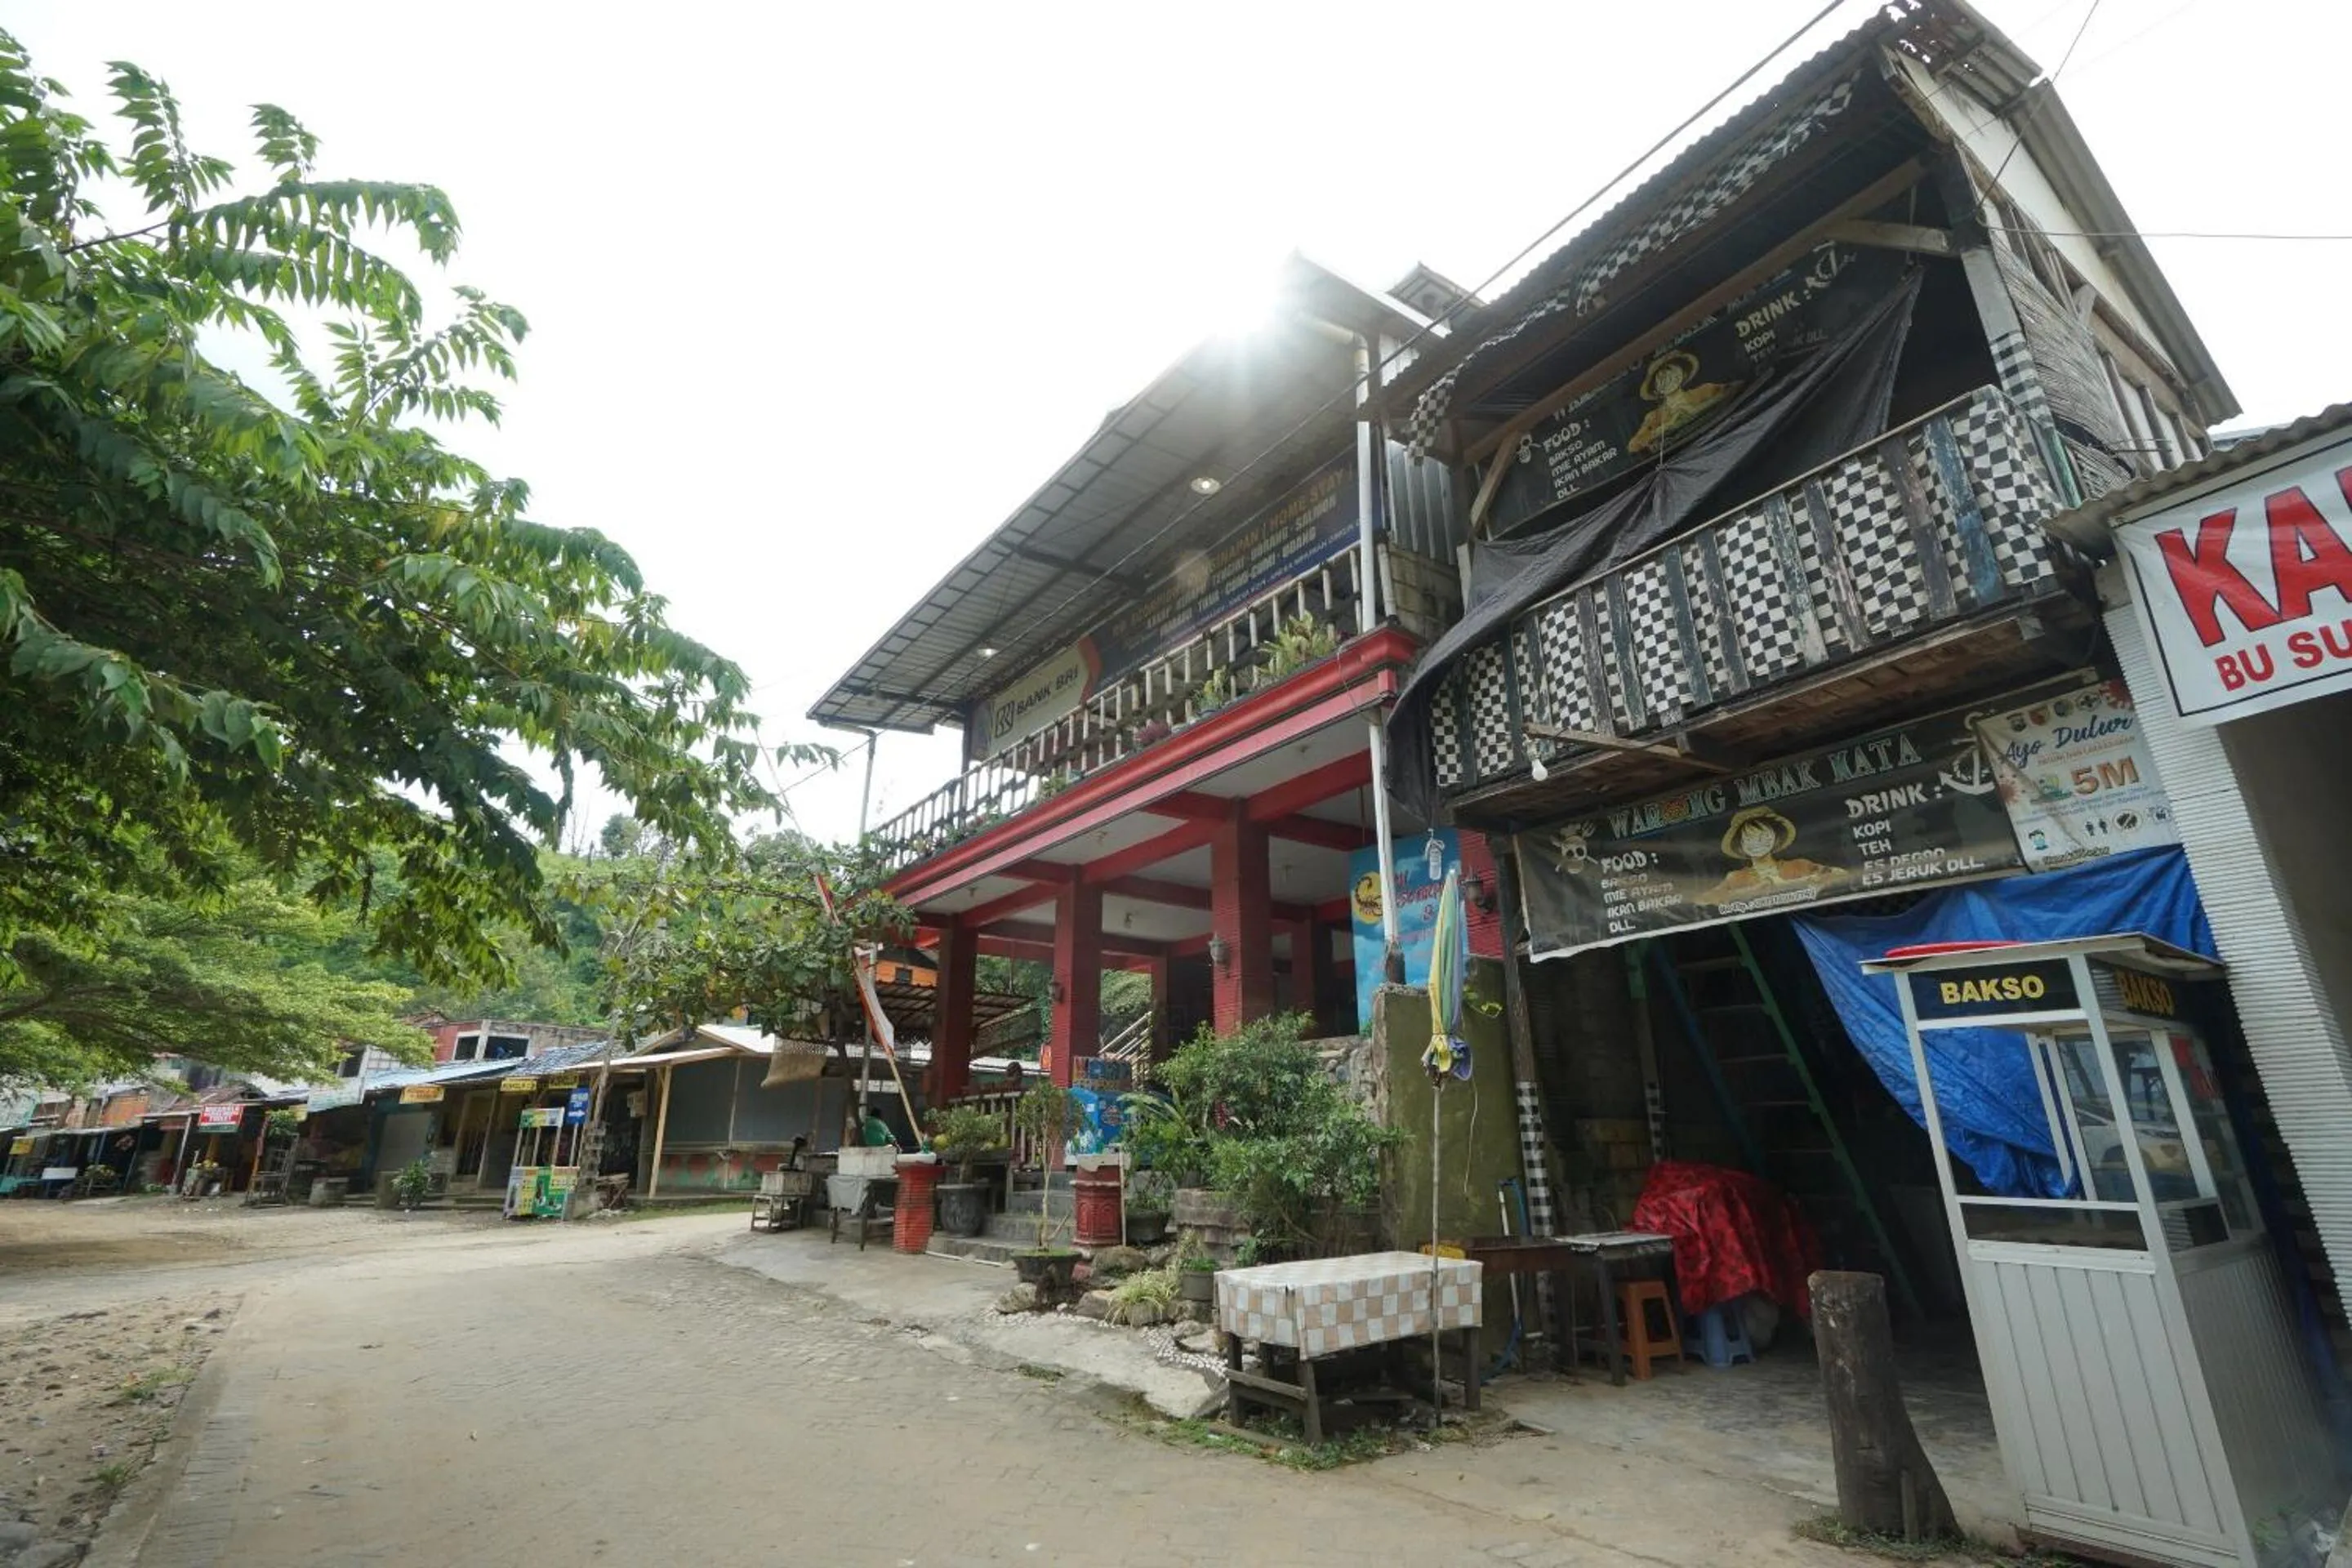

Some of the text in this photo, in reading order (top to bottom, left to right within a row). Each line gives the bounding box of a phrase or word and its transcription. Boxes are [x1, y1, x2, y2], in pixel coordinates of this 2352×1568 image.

[1735, 291, 1800, 338] DRINK
[1744, 329, 1776, 353] KOPI
[1542, 422, 1581, 452] FOOD
[1548, 440, 1583, 466] BAKSO
[1551, 461, 1572, 478] MIE
[1553, 448, 1619, 489] IKAN BAKAR
[2154, 465, 2352, 648] KA
[2214, 643, 2274, 693] BU
[2006, 739, 2045, 769] Ayo
[1732, 760, 1821, 808] MBAK
[2070, 755, 2140, 795] 5M
[1845, 782, 1928, 818] DRINK
[1852, 819, 1892, 840] KOPI
[1857, 837, 1892, 857] TEH
[1601, 850, 1647, 875] FOOD
[1862, 871, 1883, 887] ES
[1888, 861, 1943, 882] JERUK
[1601, 872, 1648, 889] BASO
[1603, 888, 1628, 904] MIE
[1607, 893, 1683, 919] IKAN BAKAR
[1940, 974, 2045, 1004] BAKSO
[2114, 968, 2176, 1017] BAKSO
